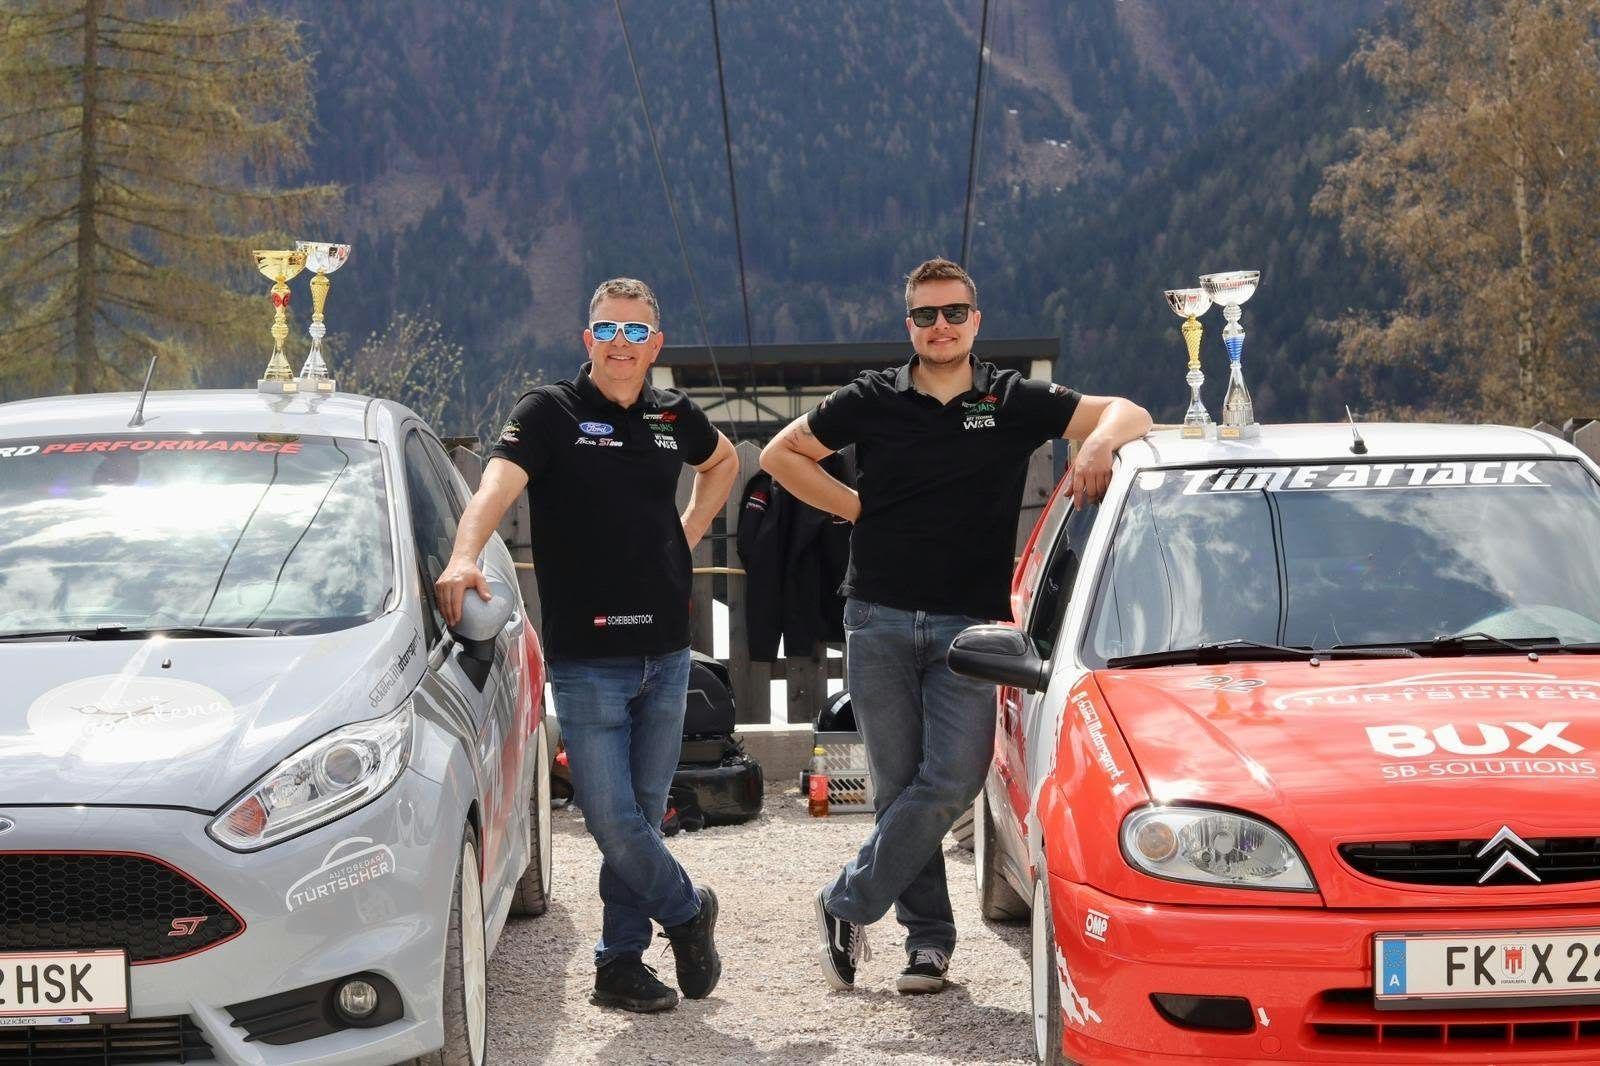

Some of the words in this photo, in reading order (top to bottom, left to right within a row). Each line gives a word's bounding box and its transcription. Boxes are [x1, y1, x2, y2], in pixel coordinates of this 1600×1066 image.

[41, 440, 304, 457] PERFORMANCE
[607, 614, 654, 625] SCHEIBENSTOCK
[1365, 721, 1585, 758] BUX
[1381, 760, 1597, 779] SB-SOLUTIONS
[168, 916, 208, 936] ST
[1085, 913, 1108, 937] OMP
[1446, 945, 1496, 986] FK
[1532, 943, 1553, 985] X
[16, 963, 93, 1004] HSK
[1389, 974, 1400, 986] A
